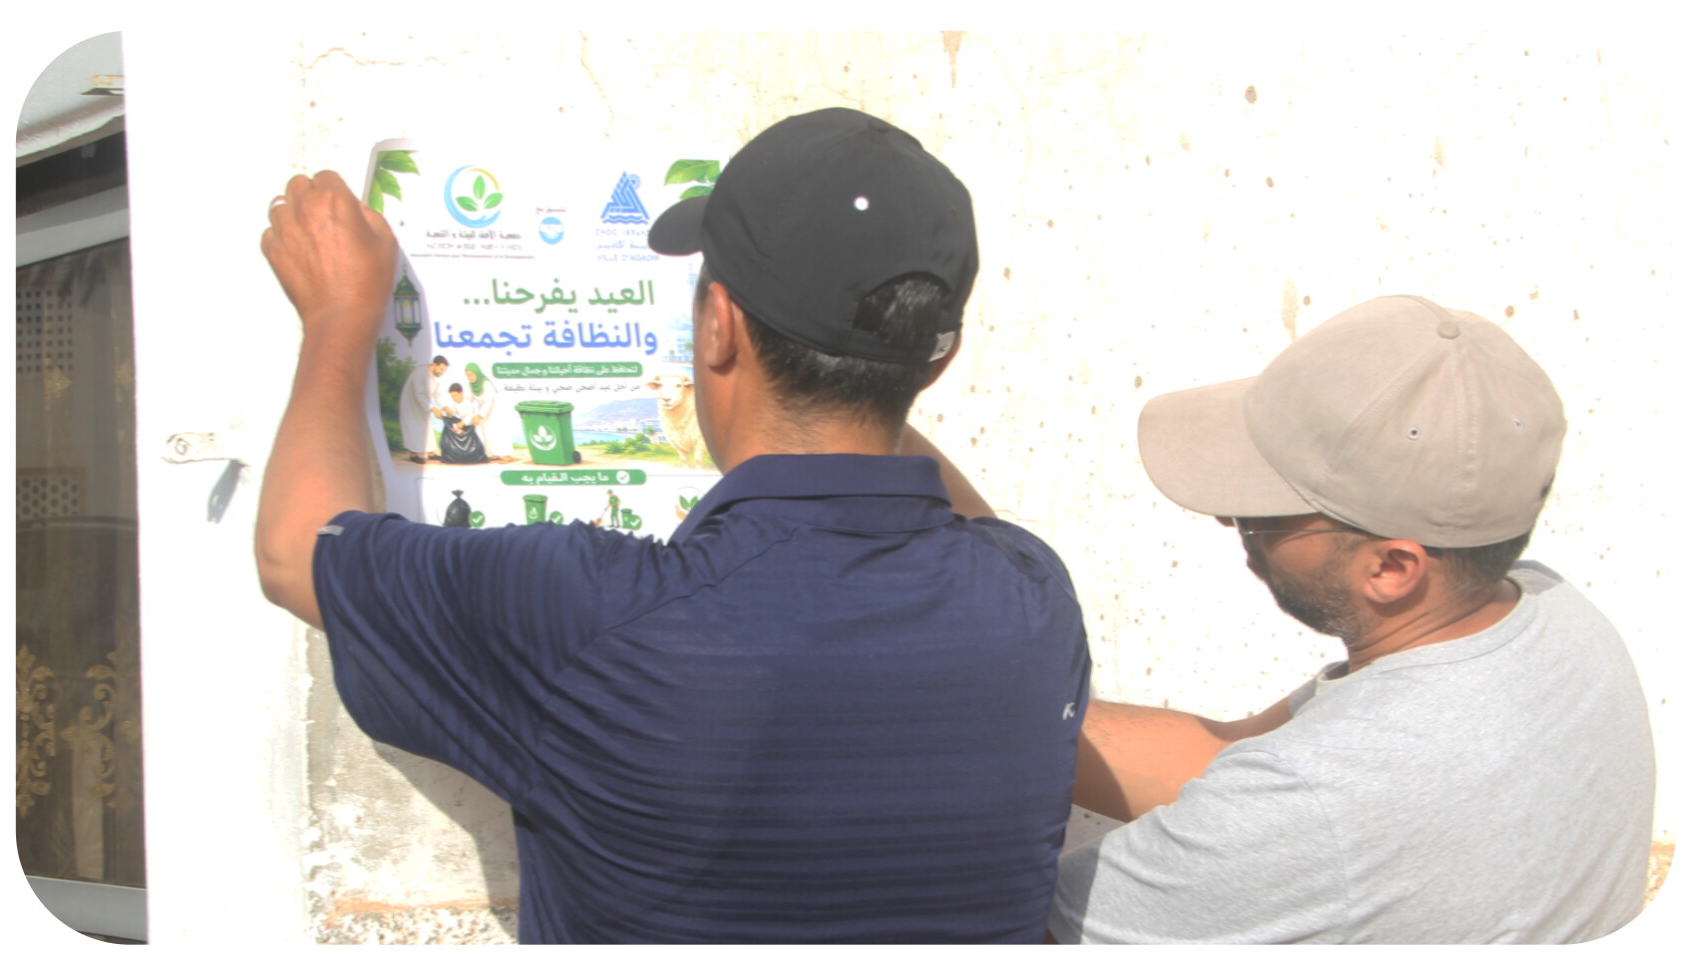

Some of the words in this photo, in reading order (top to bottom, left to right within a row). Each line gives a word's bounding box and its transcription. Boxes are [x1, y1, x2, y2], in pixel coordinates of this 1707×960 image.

[587, 280, 655, 313] العيد
[433, 321, 532, 356] تجمعنا
[543, 320, 658, 355] والنظافة
[521, 475, 534, 484] به
[536, 472, 568, 485] القيام
[571, 474, 596, 484] يجب
[597, 472, 609, 482] ما
